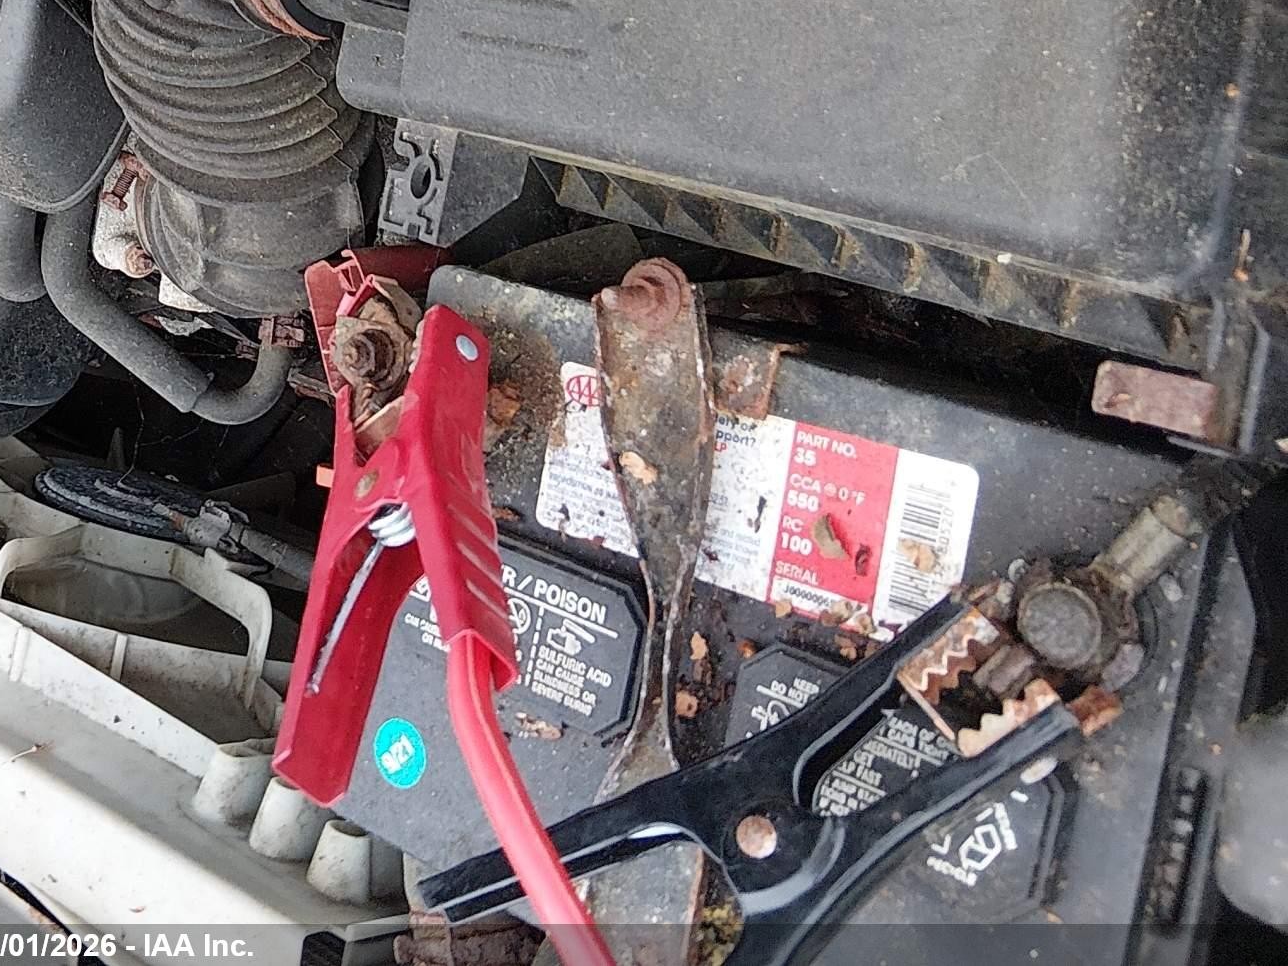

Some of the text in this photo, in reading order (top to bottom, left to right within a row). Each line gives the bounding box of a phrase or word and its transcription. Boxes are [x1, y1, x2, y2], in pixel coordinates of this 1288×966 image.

[715, 430, 756, 447] pport?
[796, 431, 858, 459] PART NO.
[794, 447, 818, 468] 35
[789, 473, 822, 494] CCA
[786, 490, 821, 513] 550
[782, 516, 804, 533] RC
[780, 533, 813, 556] 100
[775, 562, 820, 585] SERIAL
[533, 578, 608, 624] POISON
[538, 645, 587, 675] SULFURIC
[586, 666, 613, 688] ACID
[770, 680, 788, 695] DO
[793, 677, 821, 696] KEEP
